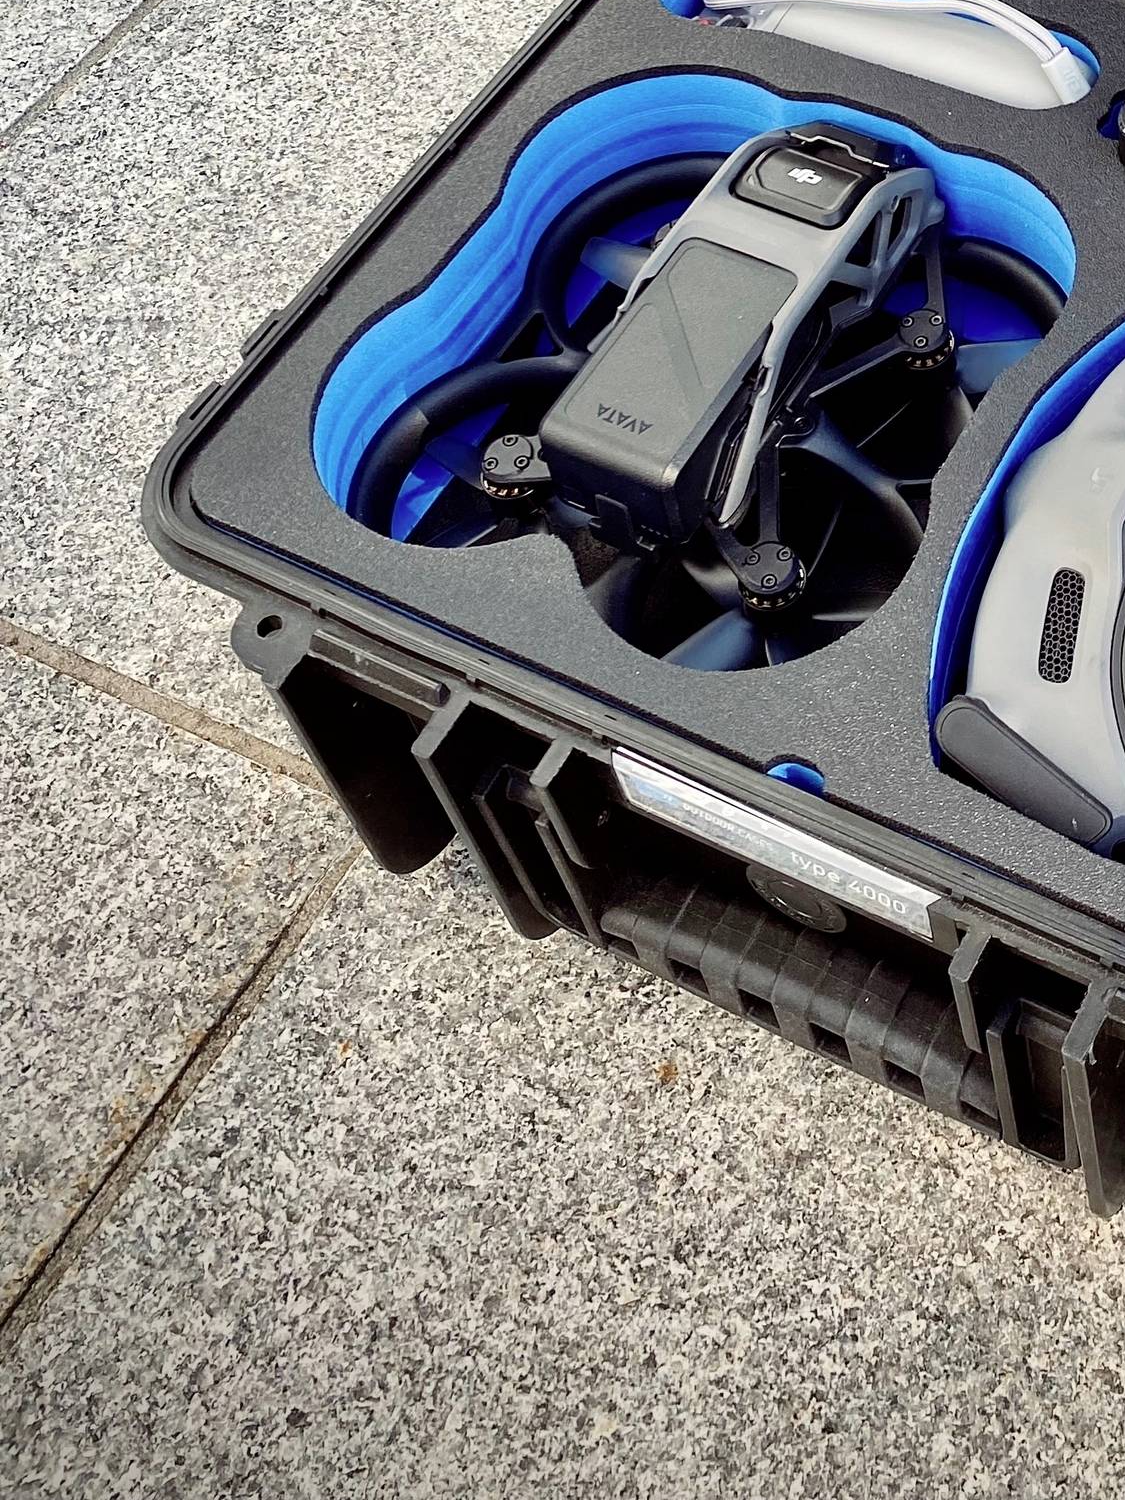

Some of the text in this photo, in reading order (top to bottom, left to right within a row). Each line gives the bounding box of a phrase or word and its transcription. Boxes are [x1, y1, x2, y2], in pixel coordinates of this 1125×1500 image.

[597, 403, 654, 435] AVATA
[790, 851, 841, 883] type
[850, 880, 906, 914] 4000
